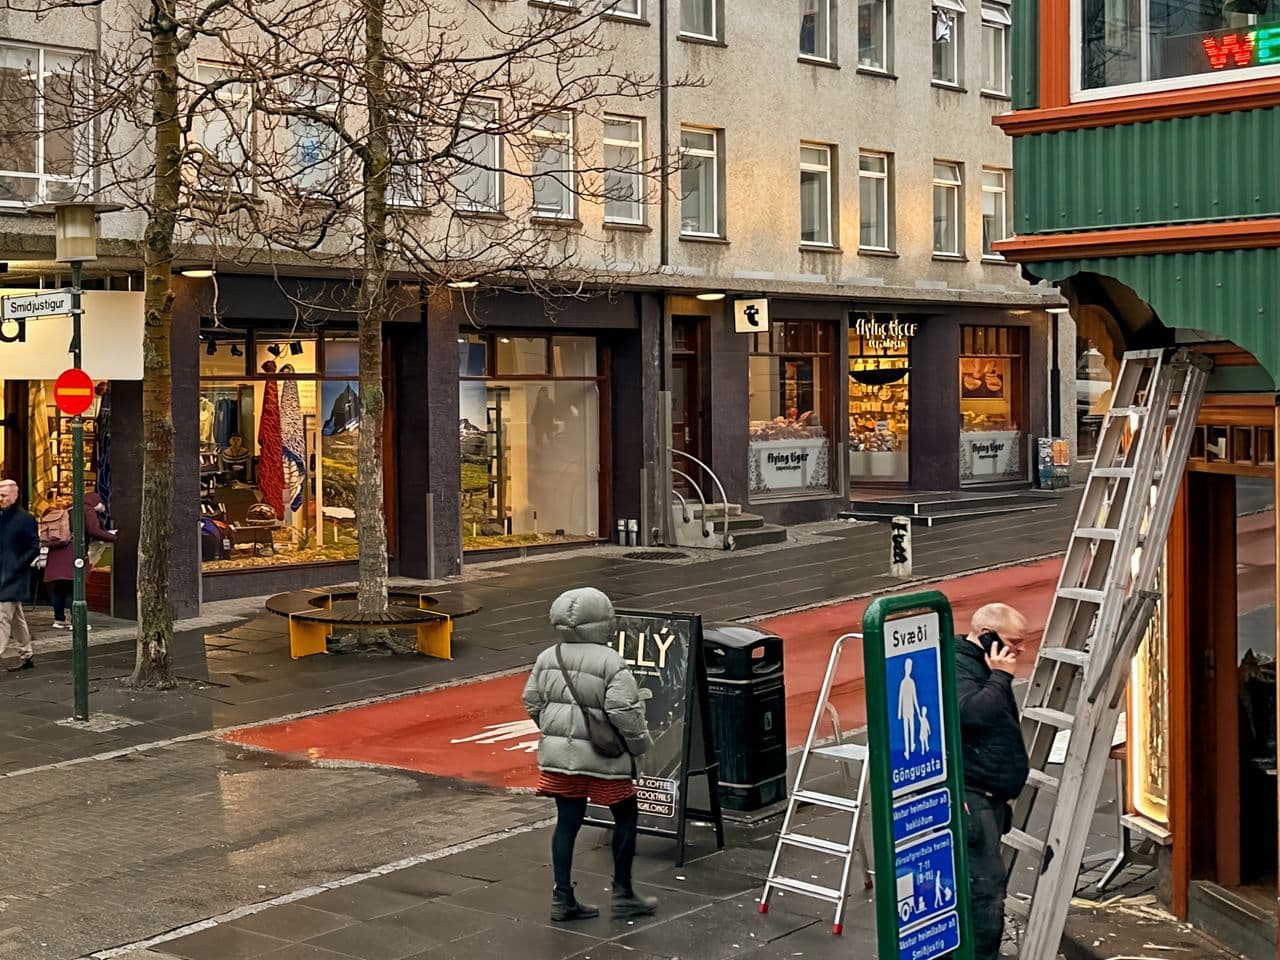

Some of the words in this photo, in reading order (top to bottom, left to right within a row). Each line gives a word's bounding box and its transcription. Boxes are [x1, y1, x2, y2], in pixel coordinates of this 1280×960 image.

[767, 452, 789, 465] flying
[790, 451, 809, 464] tiger
[607, 627, 675, 668] LLÝ
[892, 624, 928, 648] Svæði
[892, 758, 941, 783] Göngugata
